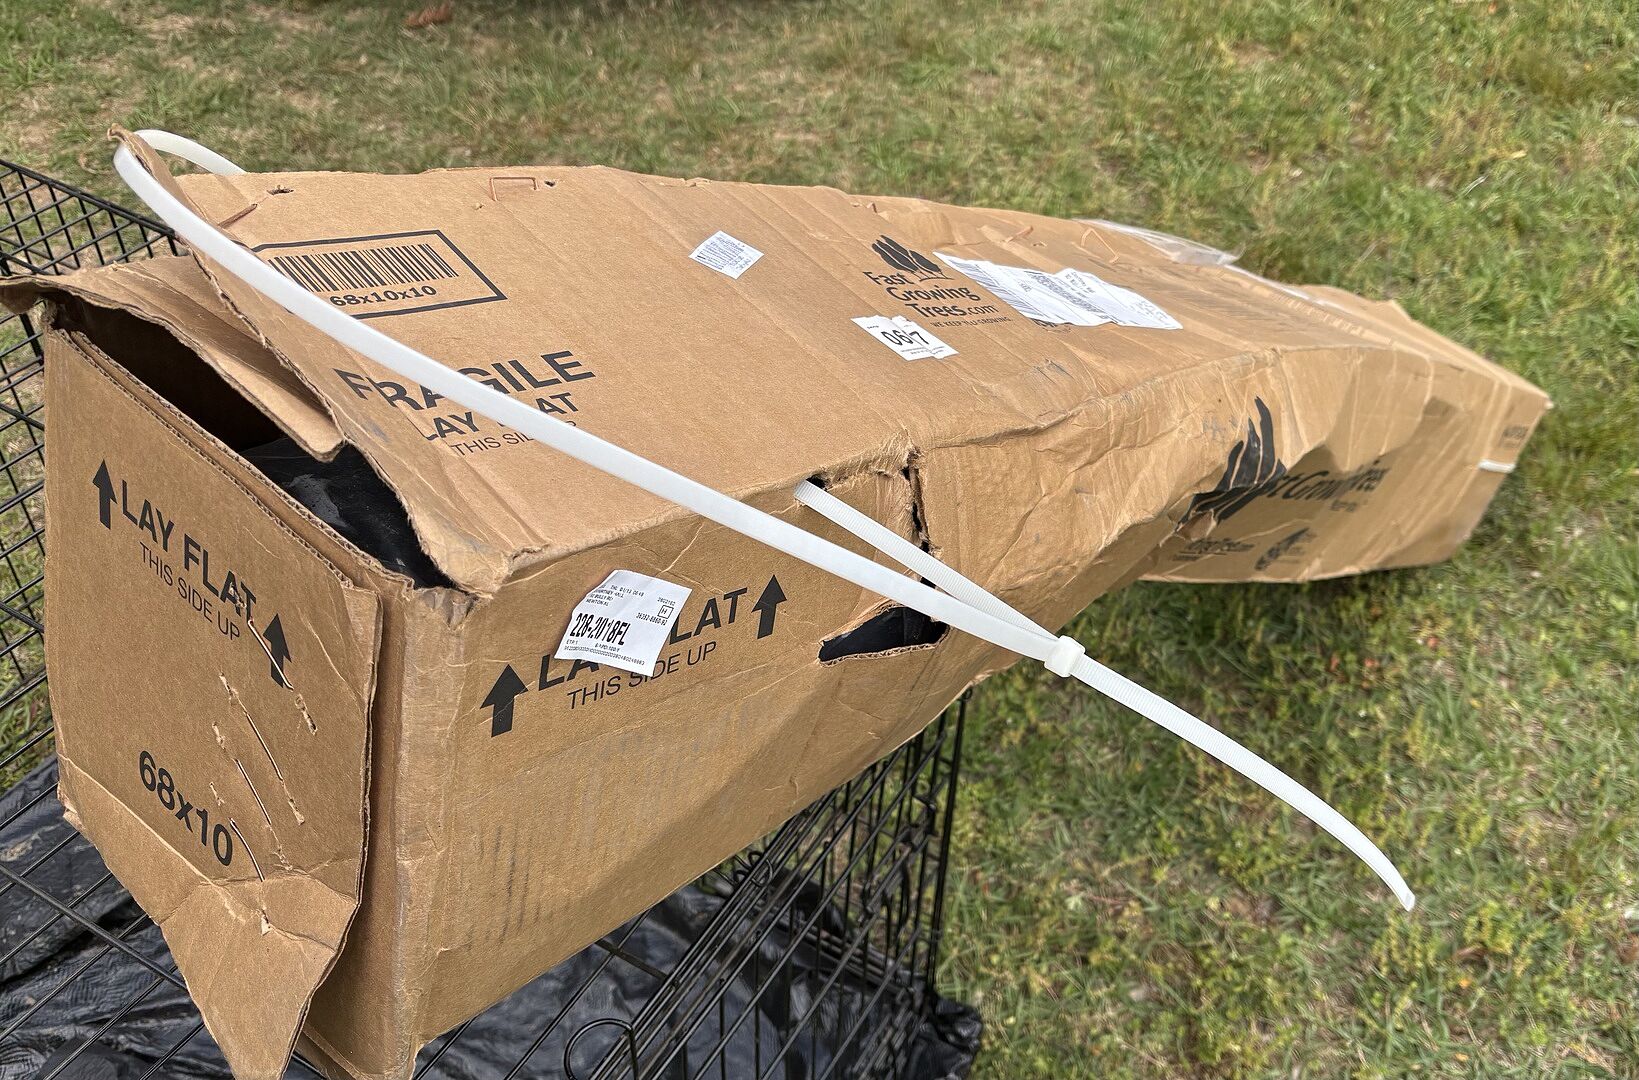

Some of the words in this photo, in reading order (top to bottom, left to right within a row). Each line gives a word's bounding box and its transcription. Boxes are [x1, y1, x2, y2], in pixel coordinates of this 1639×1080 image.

[863, 271, 914, 285] Fast
[330, 285, 437, 307] 68x10x10
[886, 285, 981, 301] Growing
[905, 303, 999, 317] Trees.com
[450, 437, 501, 456] THIS
[121, 479, 174, 552] LAY
[184, 533, 257, 621] FLAT
[140, 541, 173, 587] THIS
[178, 577, 213, 623] SIDE
[217, 611, 241, 640] UP
[567, 676, 621, 709] THIS
[687, 641, 717, 666] UP
[139, 750, 233, 866] 68x10
